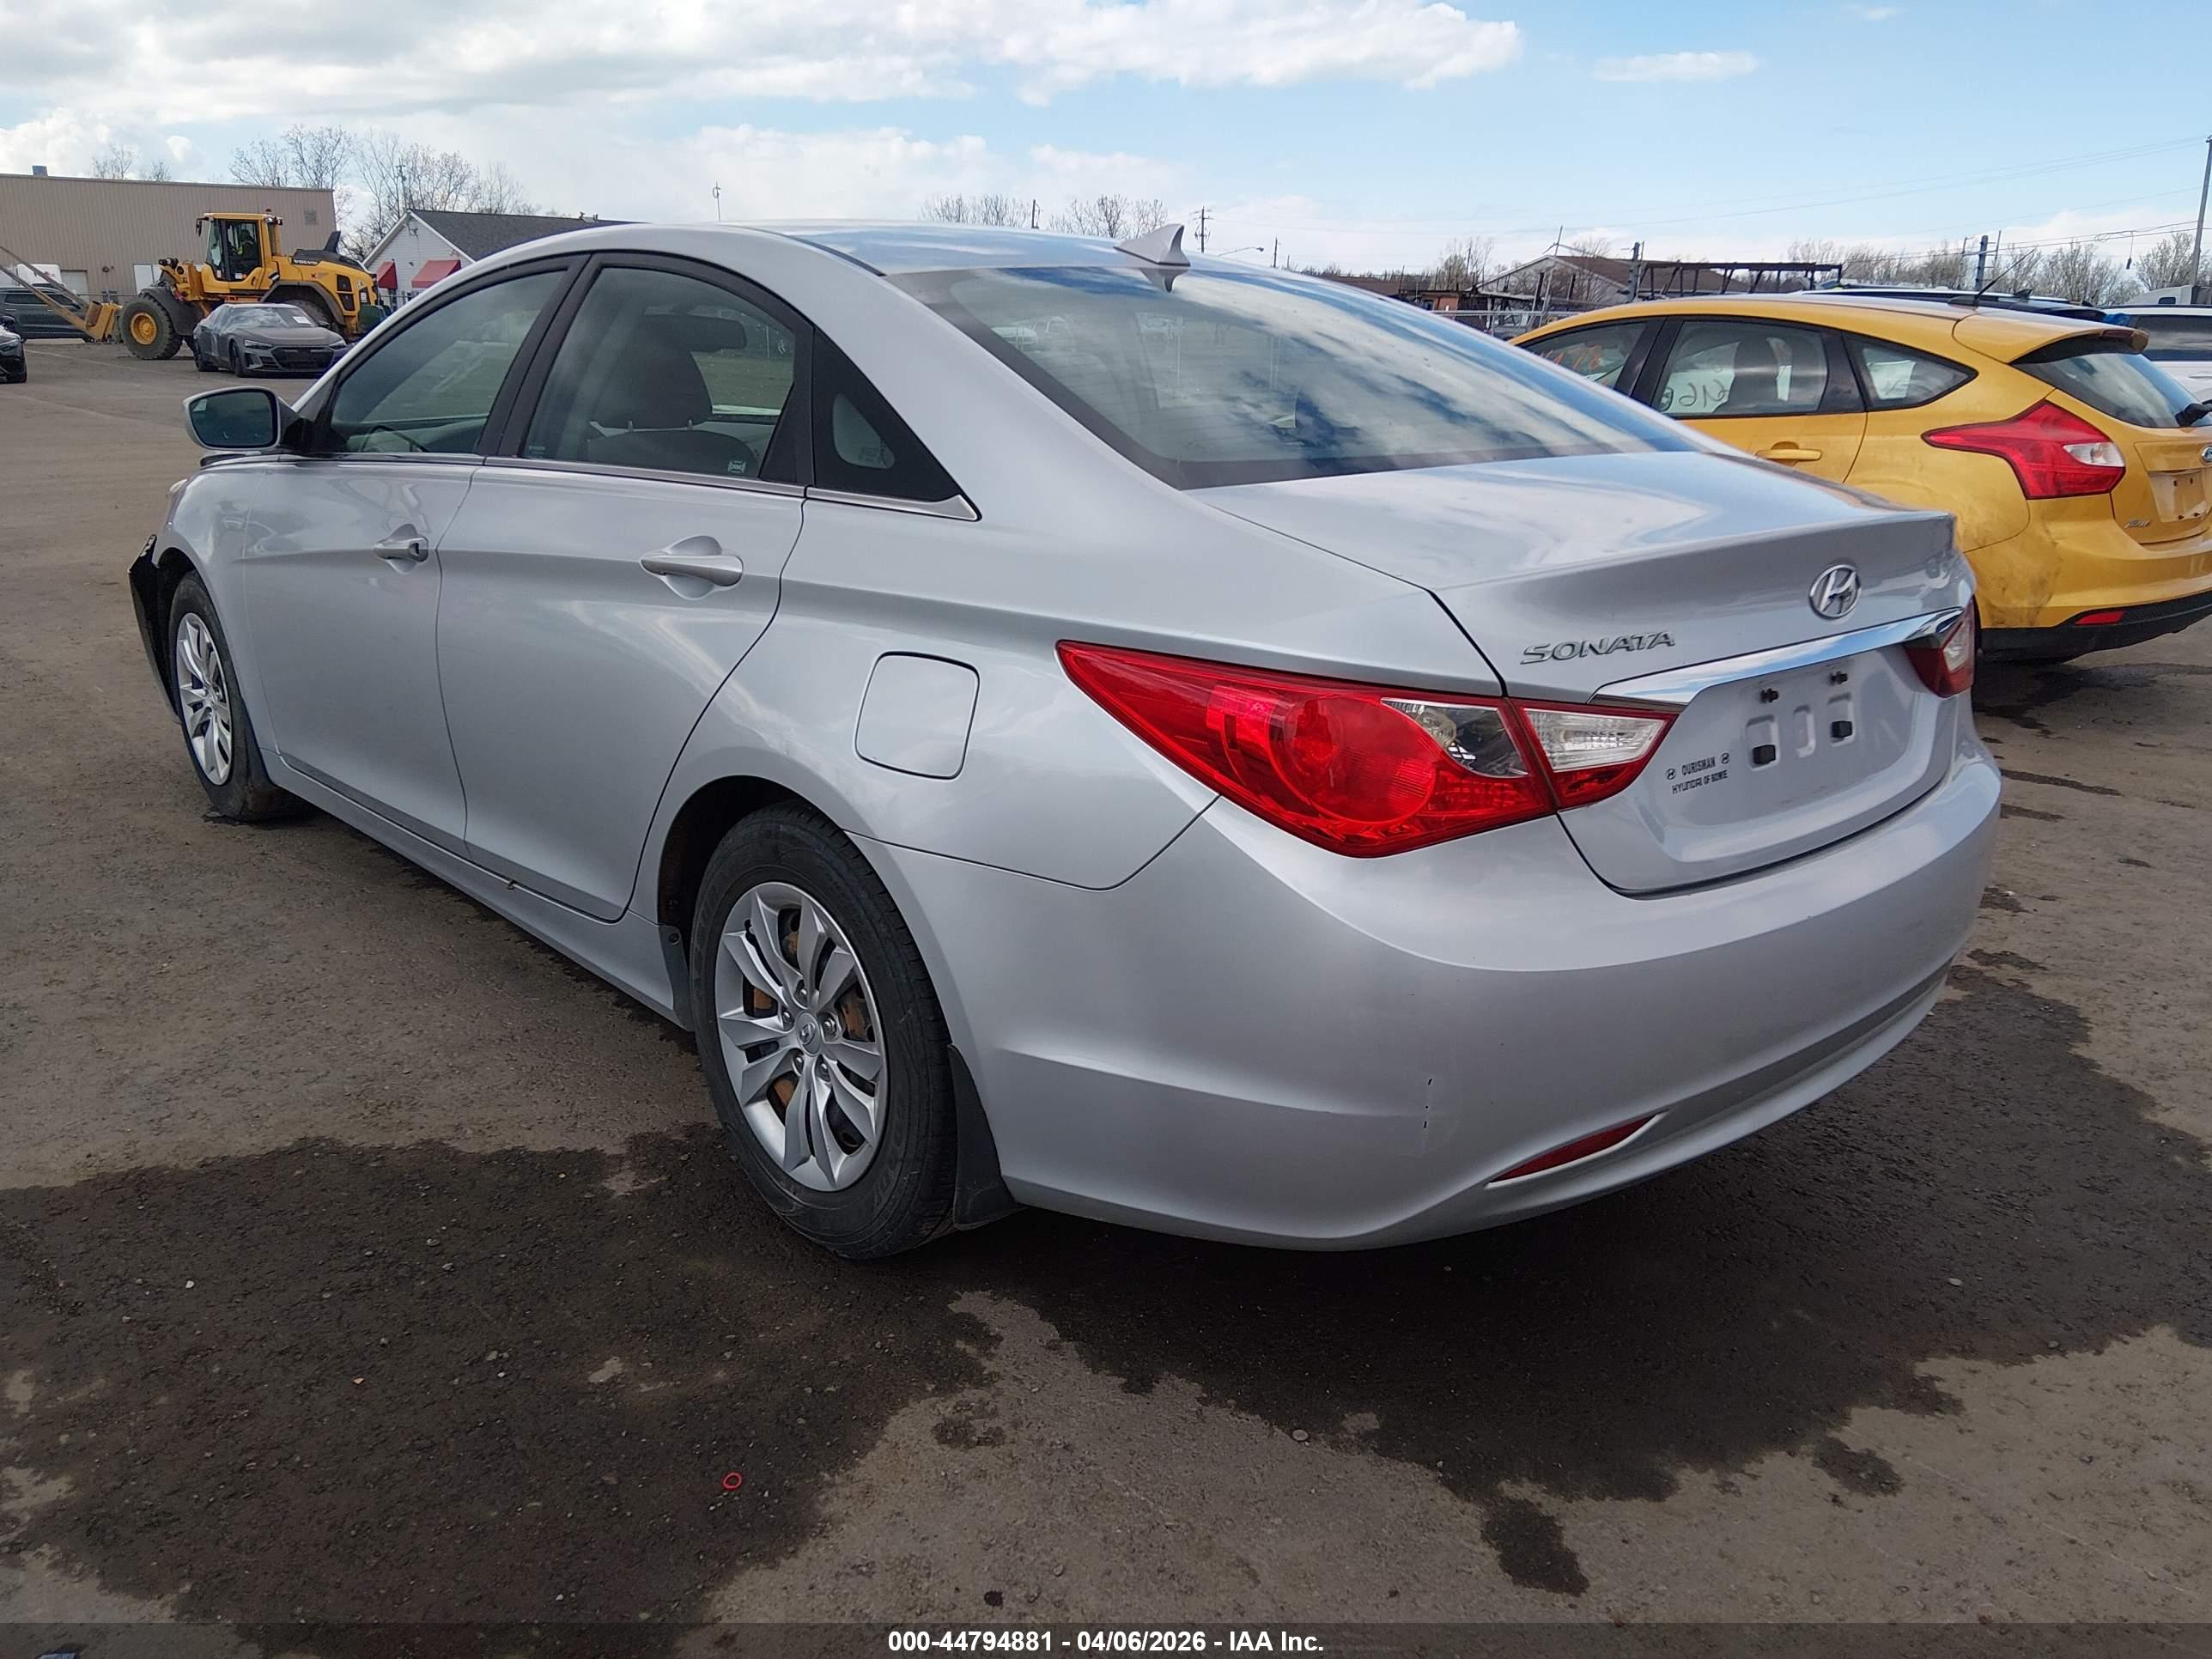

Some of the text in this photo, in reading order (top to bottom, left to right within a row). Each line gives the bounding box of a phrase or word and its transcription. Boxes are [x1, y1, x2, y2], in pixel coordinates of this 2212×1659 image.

[1520, 631, 1675, 665] SONATA
[1682, 757, 1716, 775] OURISMAN
[1703, 775, 1711, 785] OF
